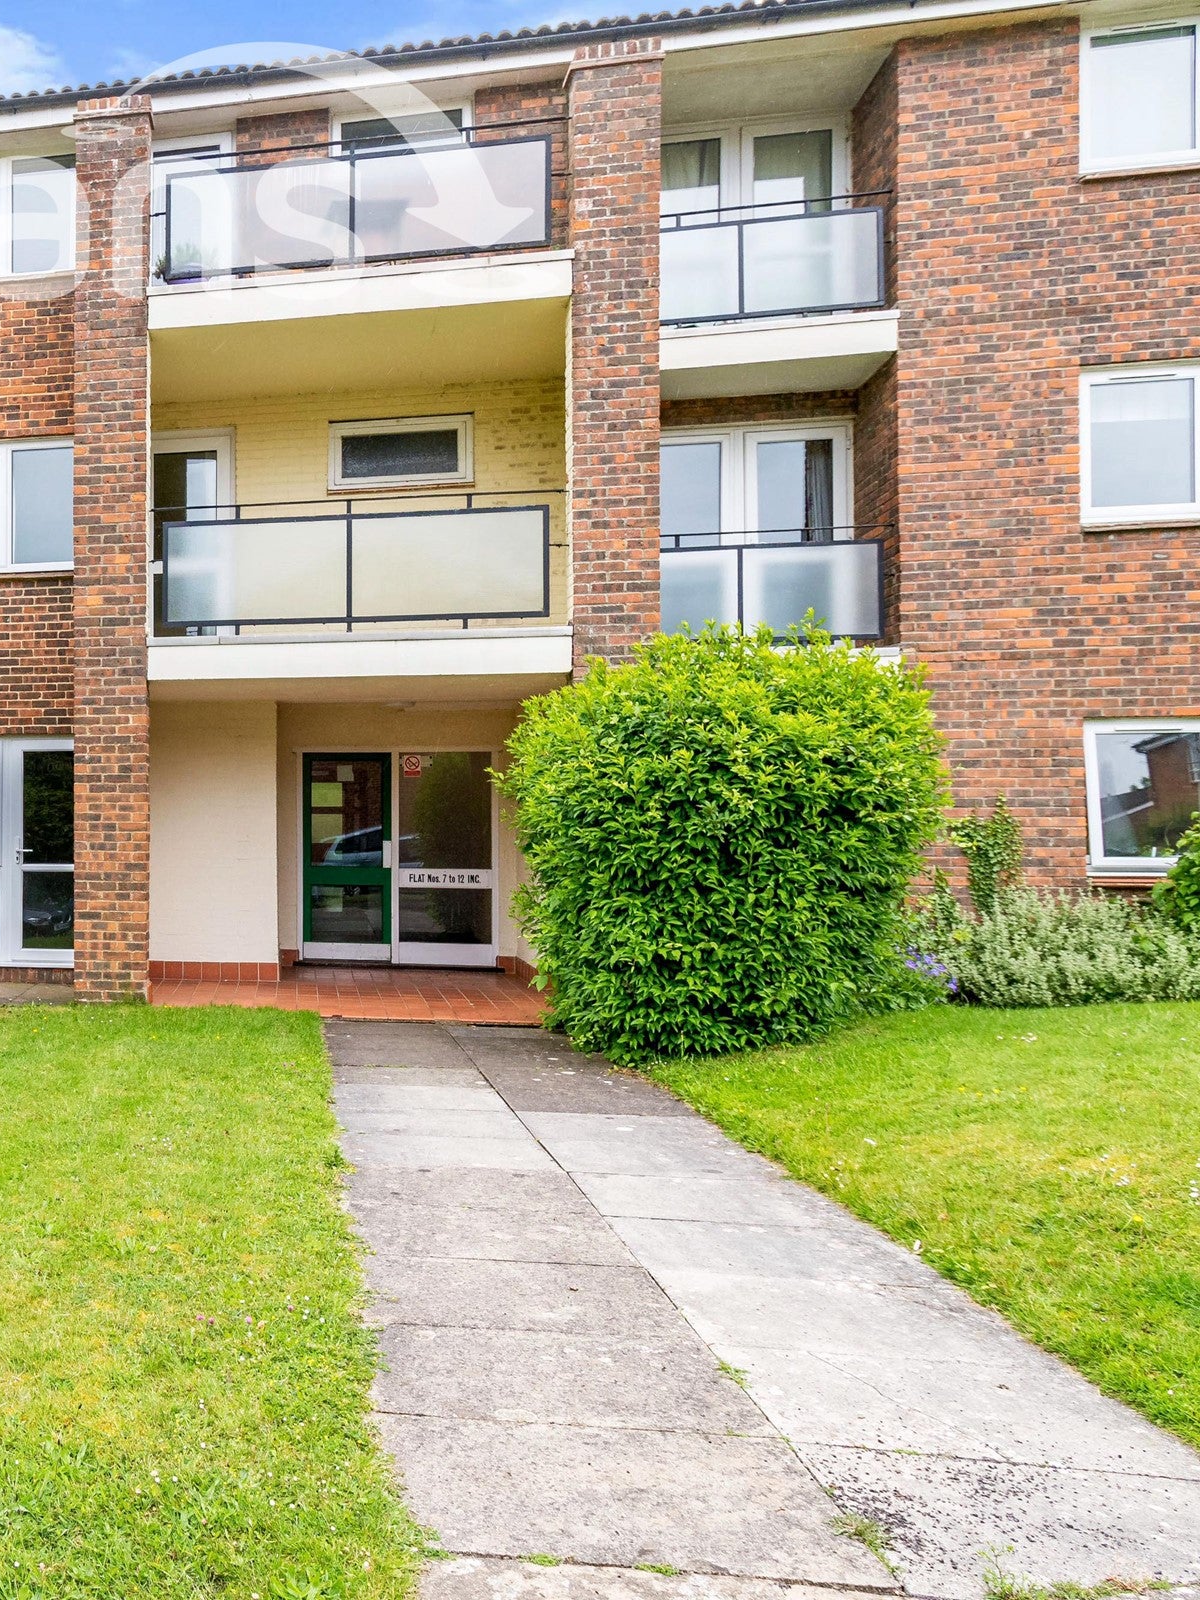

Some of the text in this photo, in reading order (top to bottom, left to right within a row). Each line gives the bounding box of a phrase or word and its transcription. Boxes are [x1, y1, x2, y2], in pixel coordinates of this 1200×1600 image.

[409, 873, 481, 884] FLAT Nos. 7 to 12 INC.
